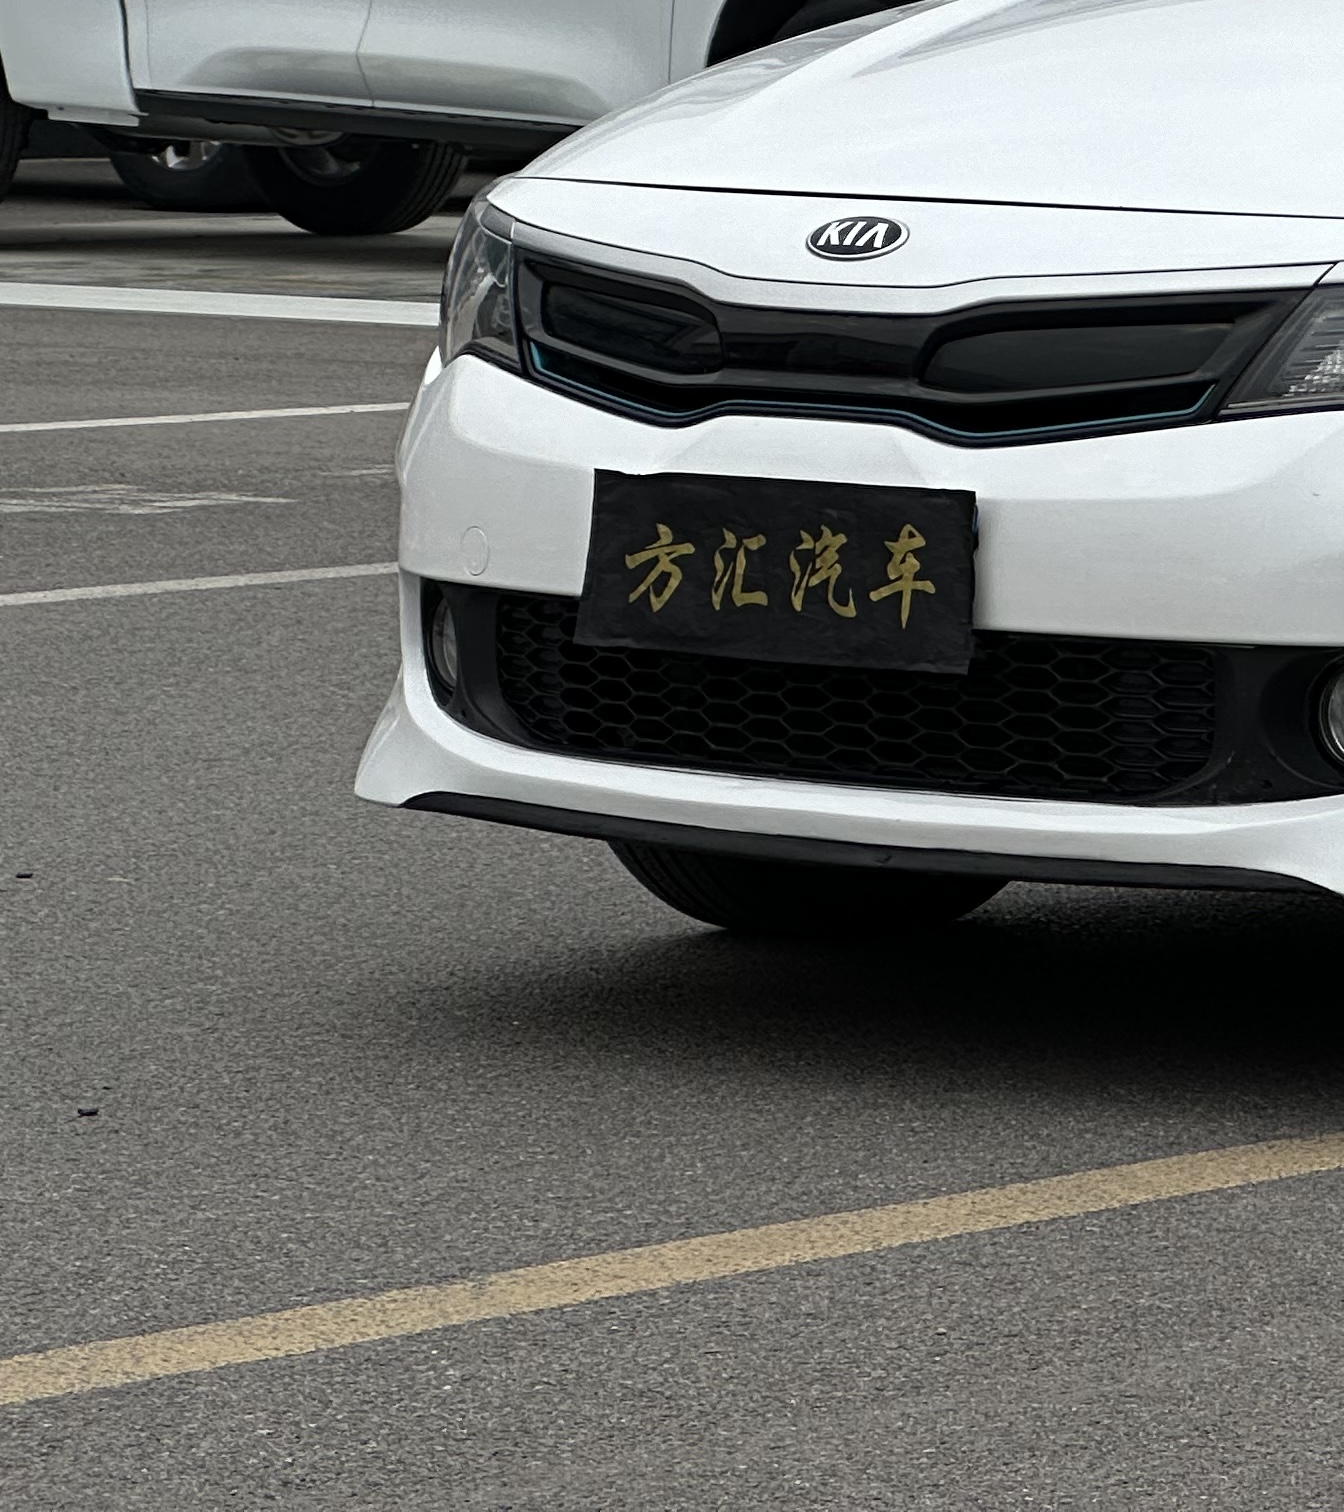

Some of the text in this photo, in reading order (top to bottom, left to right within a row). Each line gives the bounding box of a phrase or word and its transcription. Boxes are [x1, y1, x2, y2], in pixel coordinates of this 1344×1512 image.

[816, 221, 890, 249] KIA
[625, 523, 936, 630] 方汇汽车
